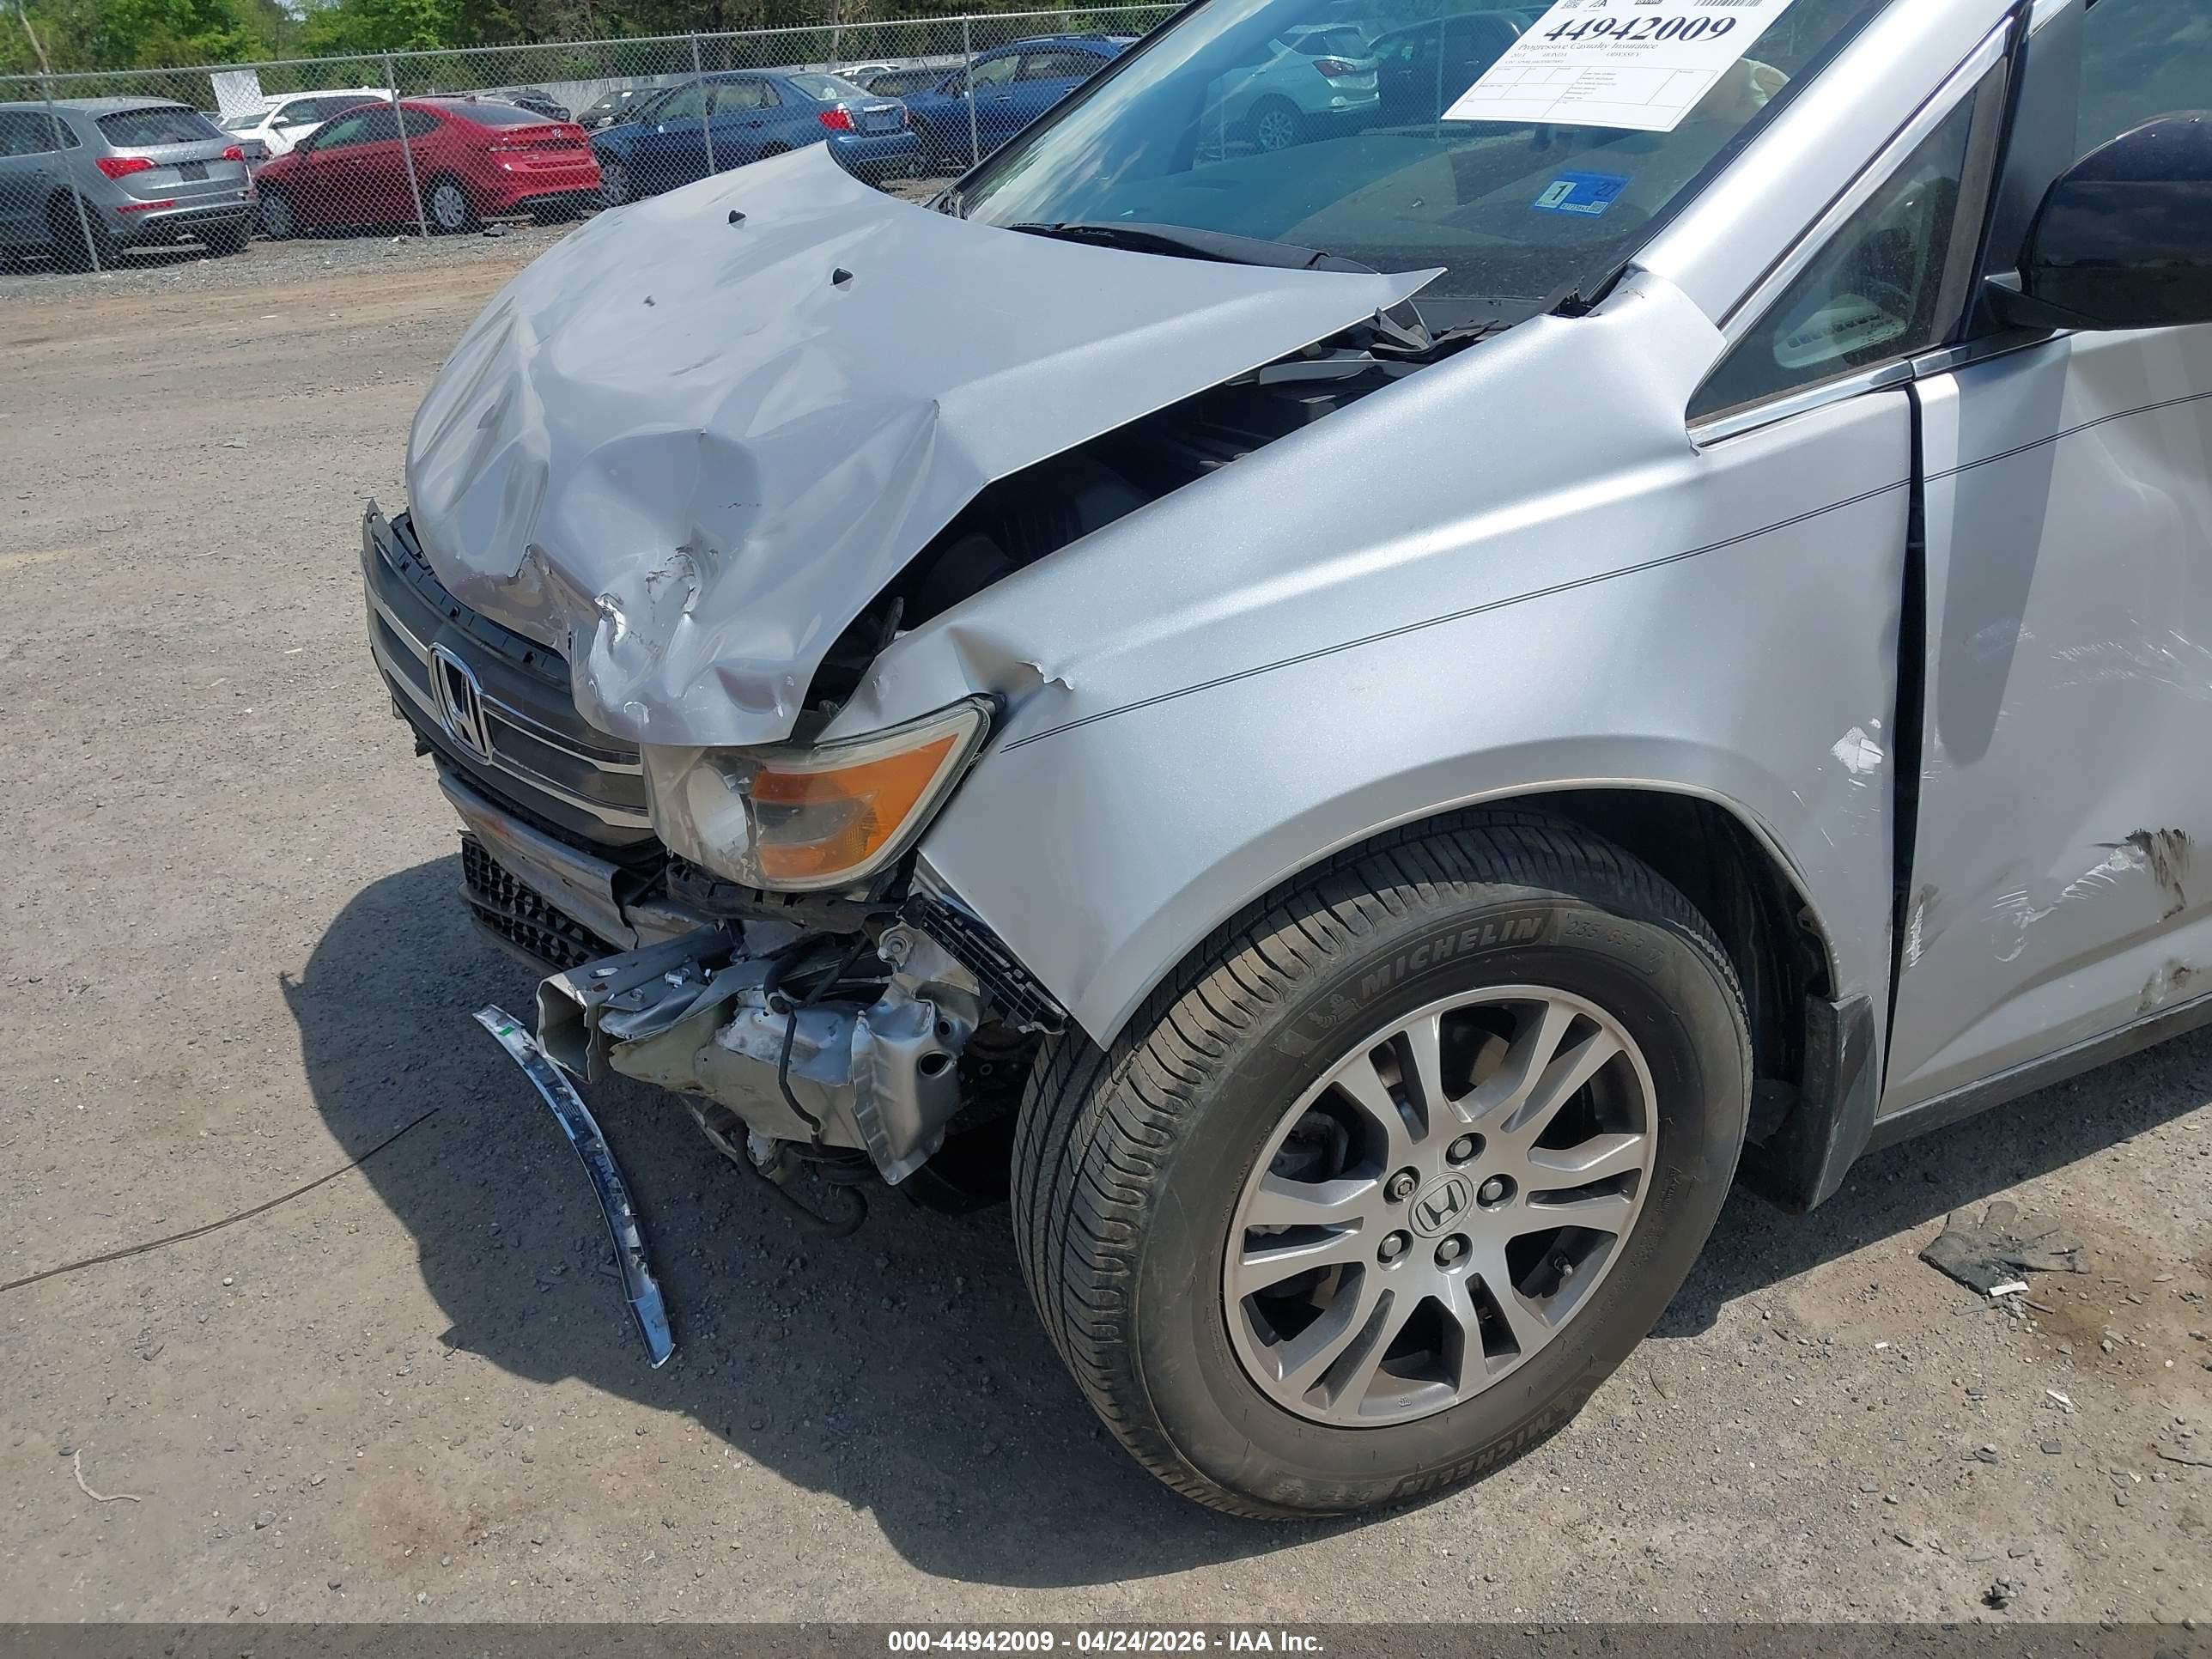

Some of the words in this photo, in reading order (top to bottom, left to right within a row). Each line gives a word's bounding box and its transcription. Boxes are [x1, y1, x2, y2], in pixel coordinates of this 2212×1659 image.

[1518, 43, 1569, 52] Progressive
[1570, 42, 1608, 51] Casualty
[1545, 16, 1737, 42] 44942009
[1361, 917, 1543, 1000] MICHELIN
[1395, 1413, 1553, 1498] MICHELIN
